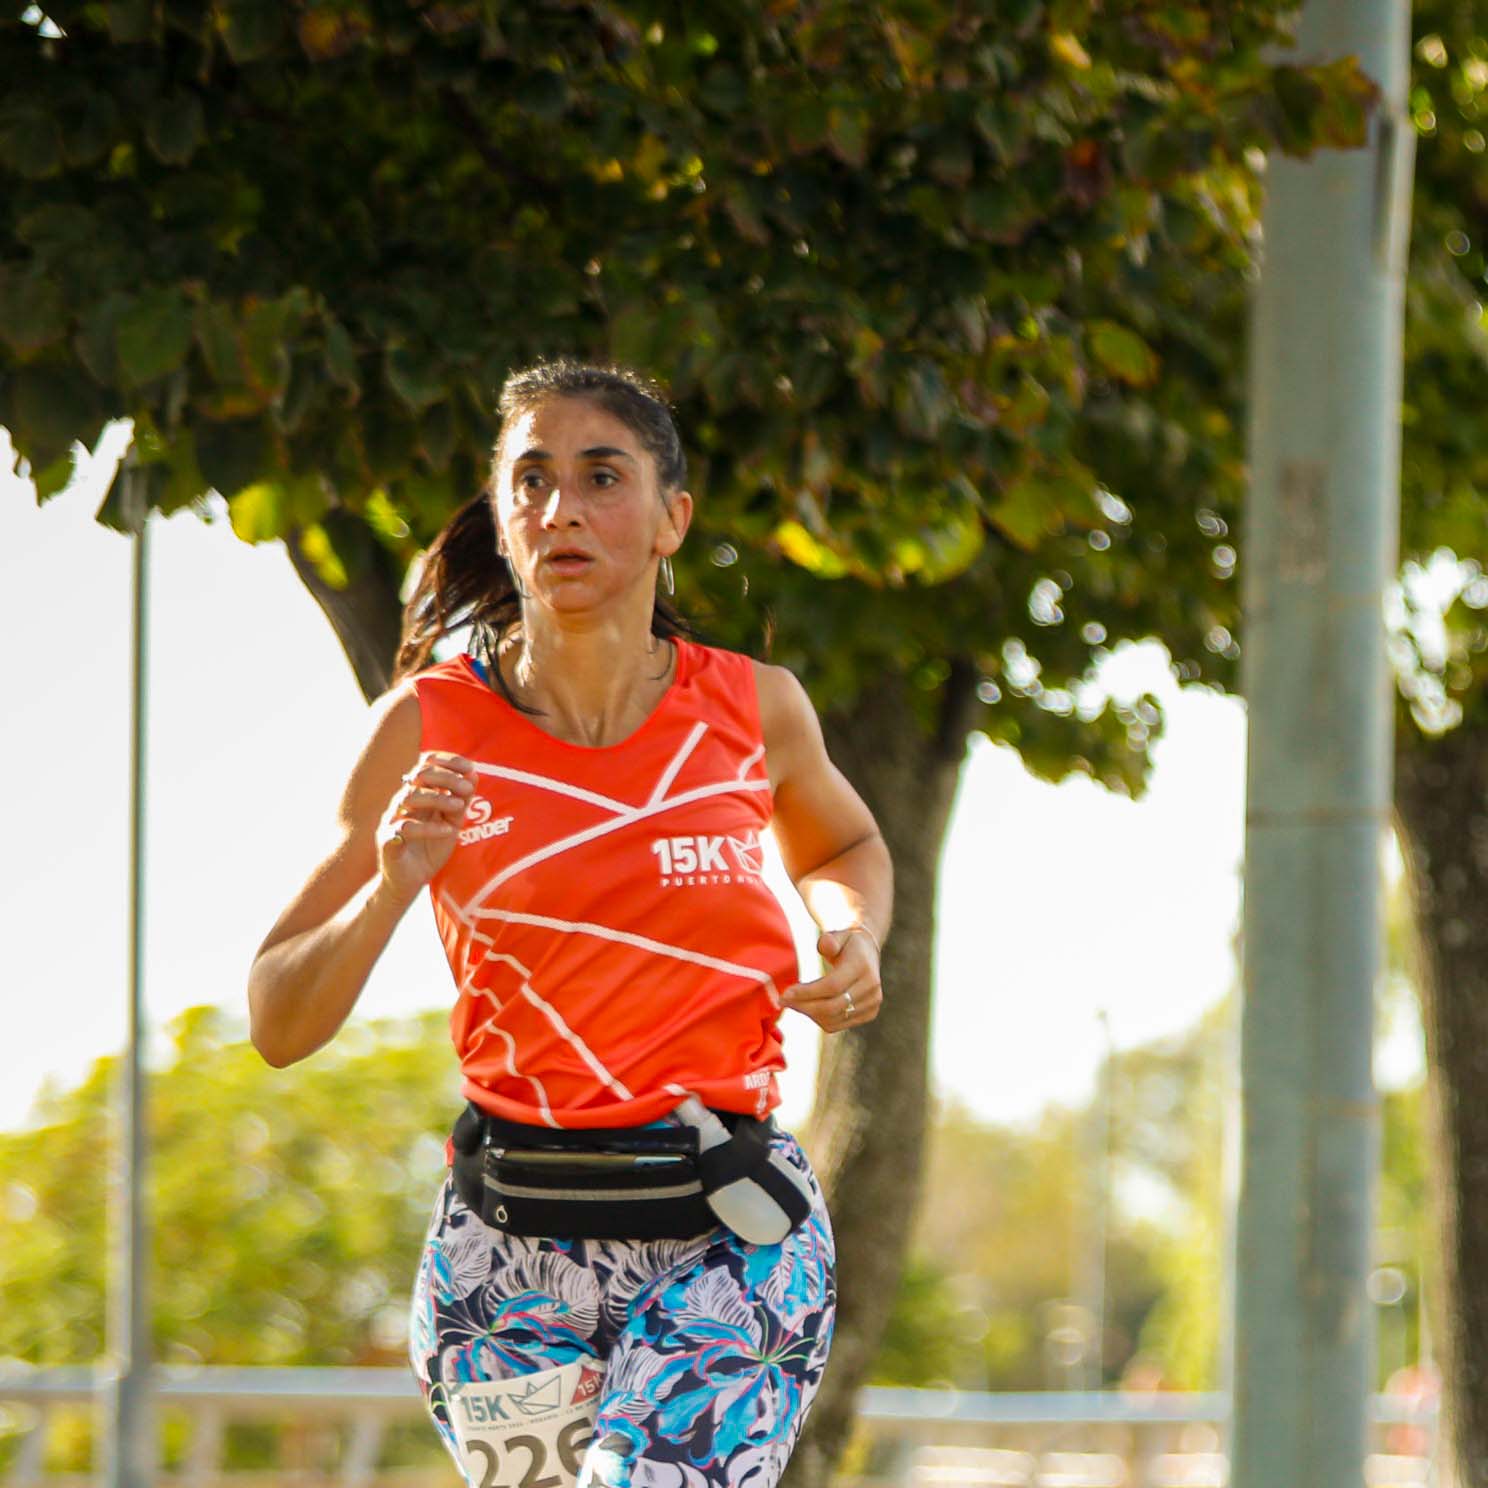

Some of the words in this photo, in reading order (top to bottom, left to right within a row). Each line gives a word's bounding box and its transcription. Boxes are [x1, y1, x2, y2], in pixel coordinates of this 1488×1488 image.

[651, 835, 729, 875] 15K
[662, 875, 731, 888] PUERTO
[461, 1392, 511, 1423] 15K
